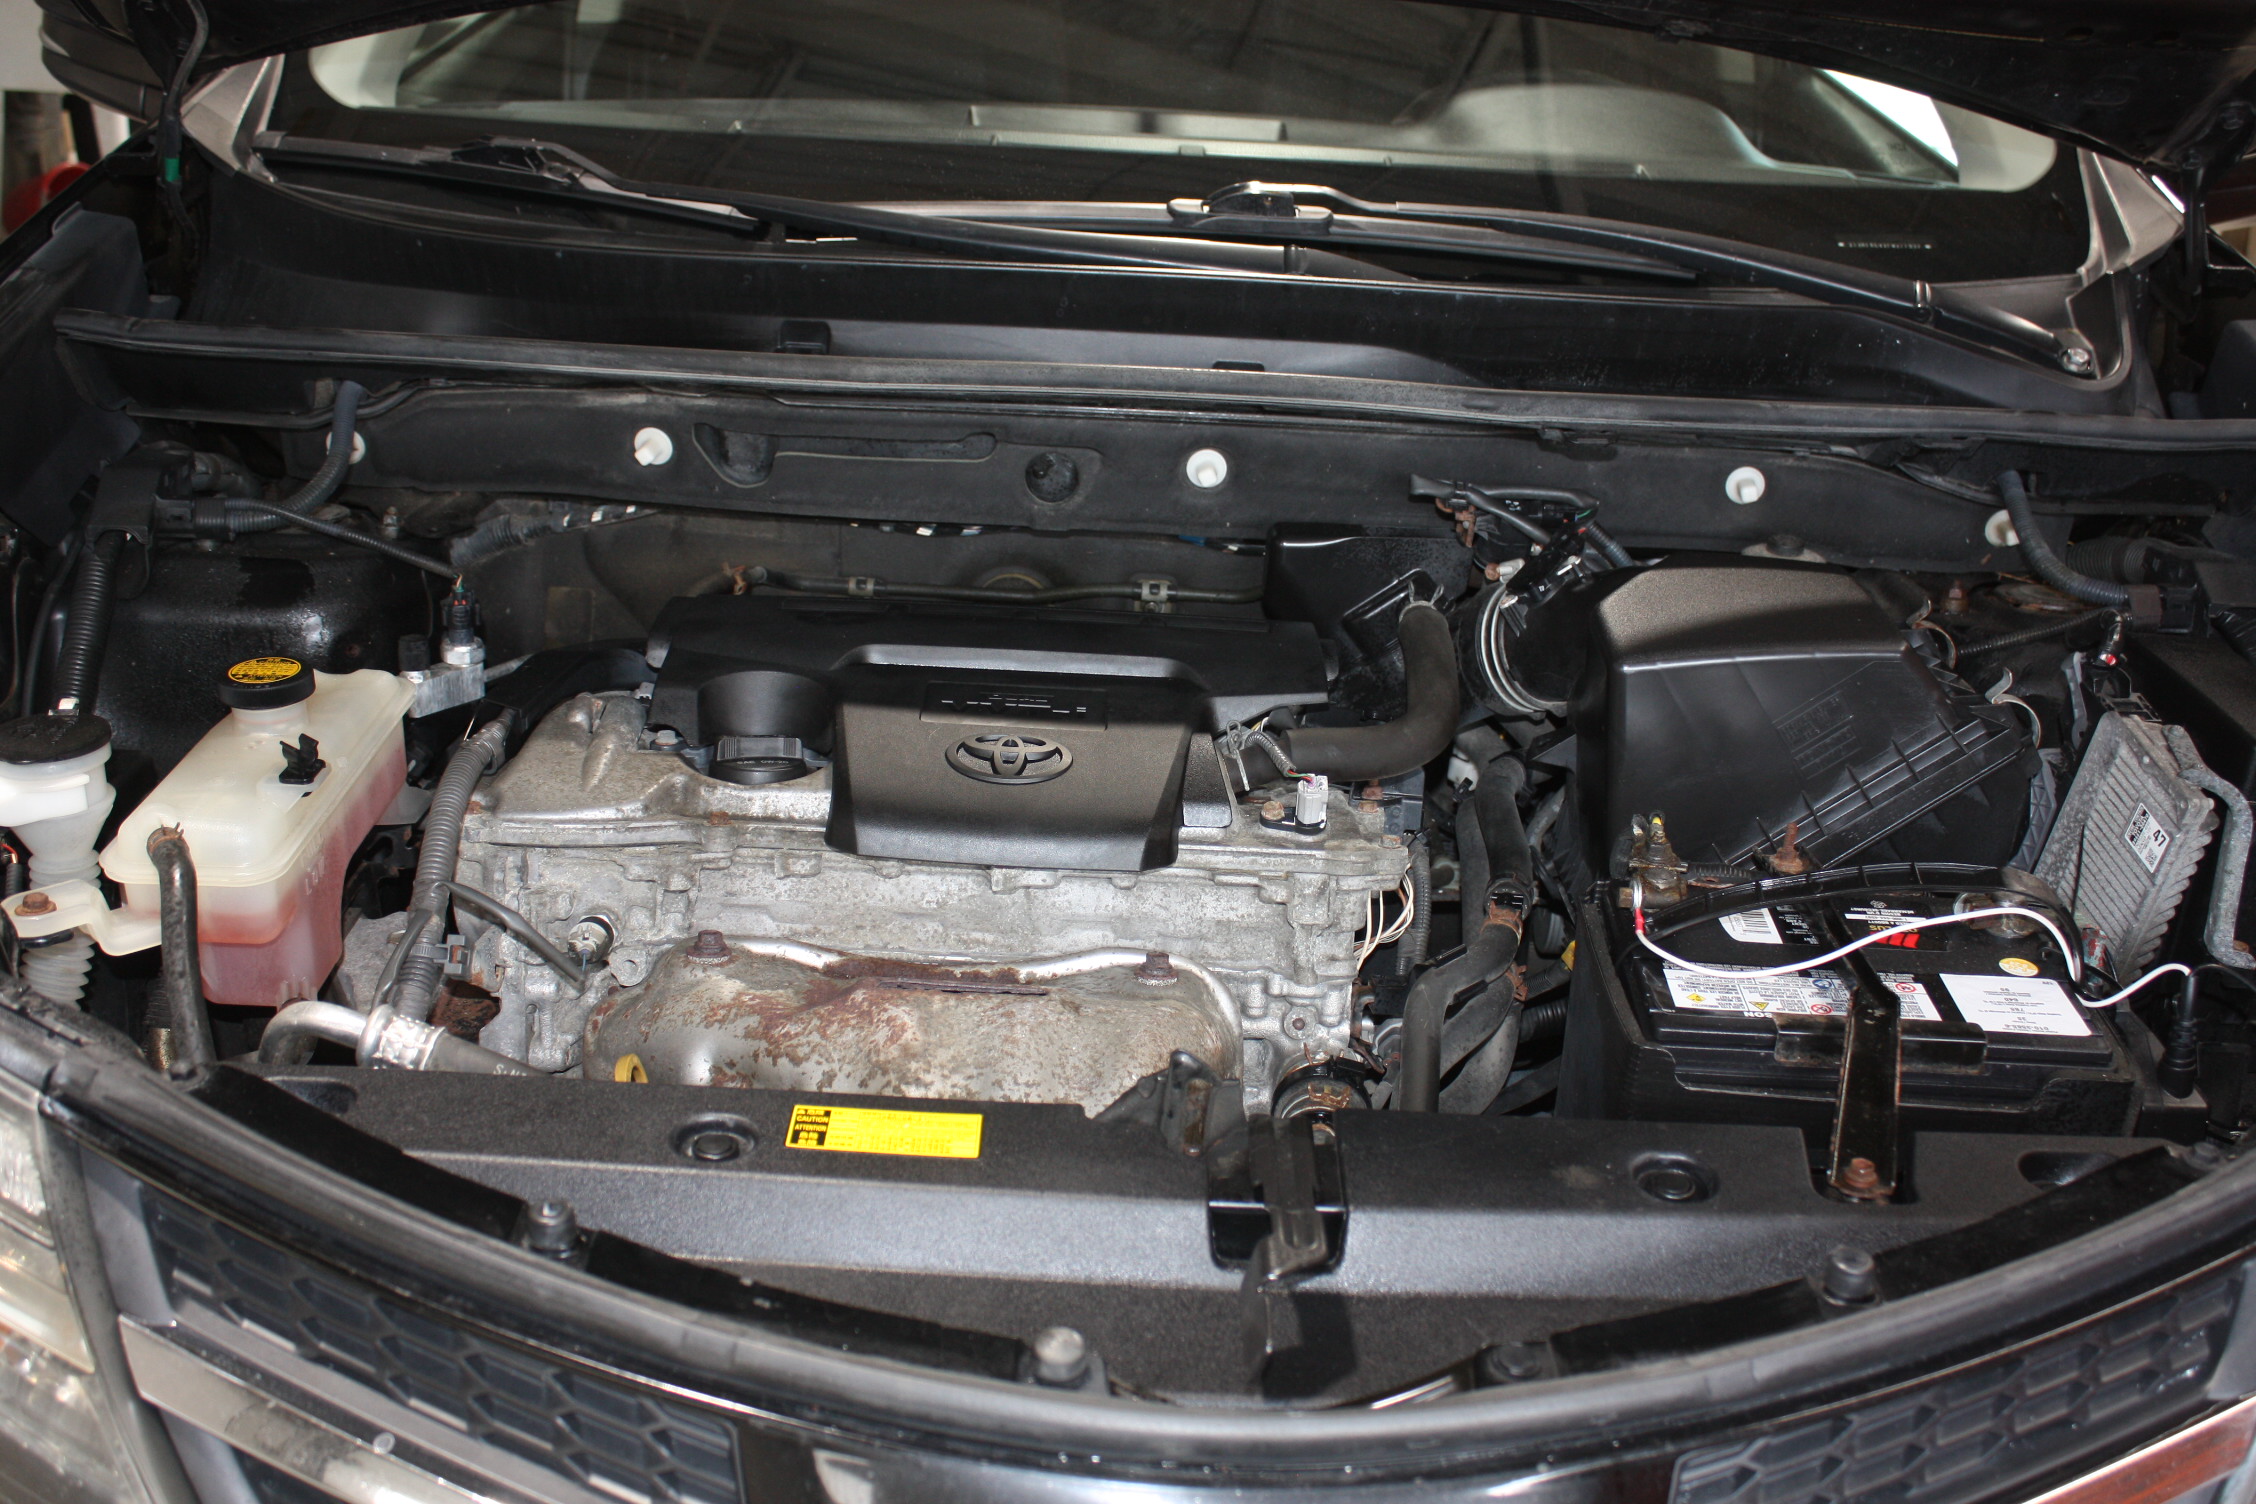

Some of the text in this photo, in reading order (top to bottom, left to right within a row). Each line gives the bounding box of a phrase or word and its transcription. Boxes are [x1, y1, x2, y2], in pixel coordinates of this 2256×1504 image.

[2152, 828, 2167, 847] 47
[796, 1116, 829, 1124] CAUTION
[794, 1124, 827, 1132] ATTENTION
